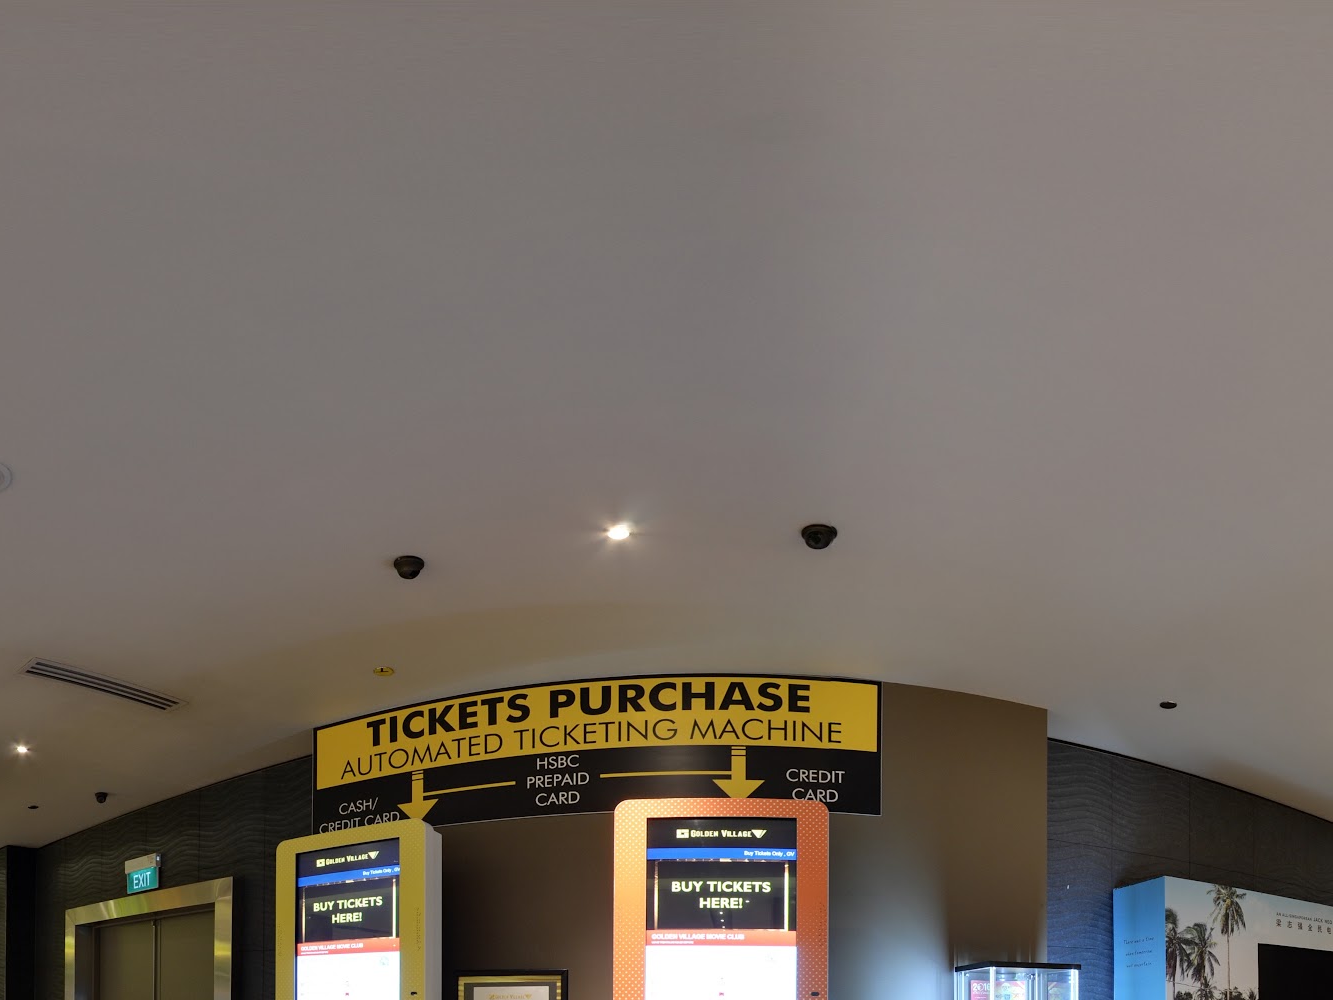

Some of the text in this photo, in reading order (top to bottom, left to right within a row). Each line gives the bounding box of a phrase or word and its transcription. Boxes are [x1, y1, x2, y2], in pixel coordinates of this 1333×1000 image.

[366, 681, 812, 747] TICKETS PURCHASE
[339, 718, 843, 780] AUTOMATED TICKETING MACHINE
[535, 754, 580, 770] HSBC
[526, 772, 590, 789] PREPAID
[785, 768, 846, 784] CREDIT
[535, 790, 581, 807] CARD
[791, 786, 839, 802] CARD
[339, 796, 379, 815] CASH/
[319, 812, 400, 834] CREDIT CARD
[691, 829, 752, 838] GOLDEN VILLAGE
[325, 854, 369, 865] GOLDEN VILLAGE
[133, 872, 151, 889] EXIT
[671, 881, 771, 892] BUY TICKETS
[313, 896, 383, 912] BUY TICKETS
[699, 898, 743, 908] HERE!
[331, 912, 363, 924] HERE!
